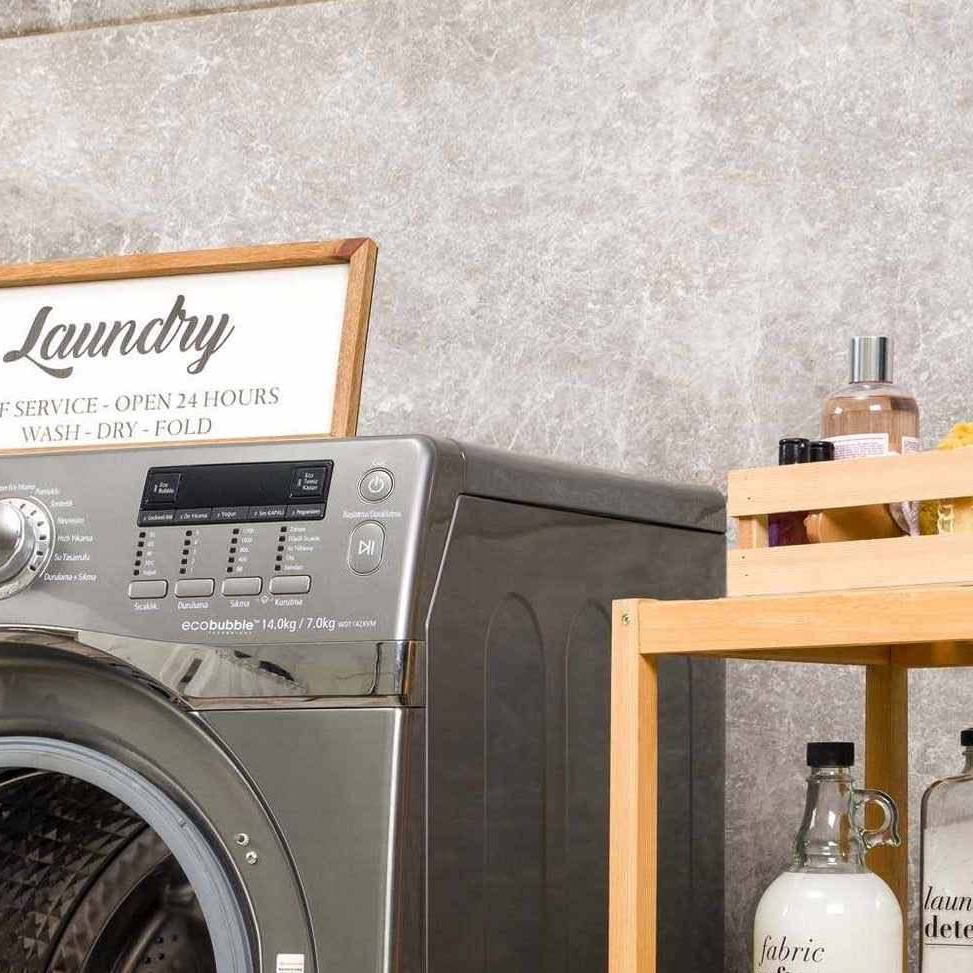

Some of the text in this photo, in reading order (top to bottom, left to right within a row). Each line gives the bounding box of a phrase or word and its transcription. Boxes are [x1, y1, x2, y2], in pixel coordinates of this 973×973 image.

[3, 294, 235, 378] Laundry
[14, 397, 98, 418] SERVICE
[114, 393, 172, 412] OPEN
[177, 392, 198, 410] 24
[203, 387, 280, 408] HOURS
[21, 424, 80, 443] WASH
[96, 421, 137, 440] DRY
[154, 418, 213, 436] FOLD
[262, 618, 297, 632] 14.0kg
[298, 618, 305, 629] /
[307, 617, 336, 631] 7.0kg
[924, 886, 973, 911] laun
[924, 915, 973, 939] dete
[759, 935, 825, 965] fabric
